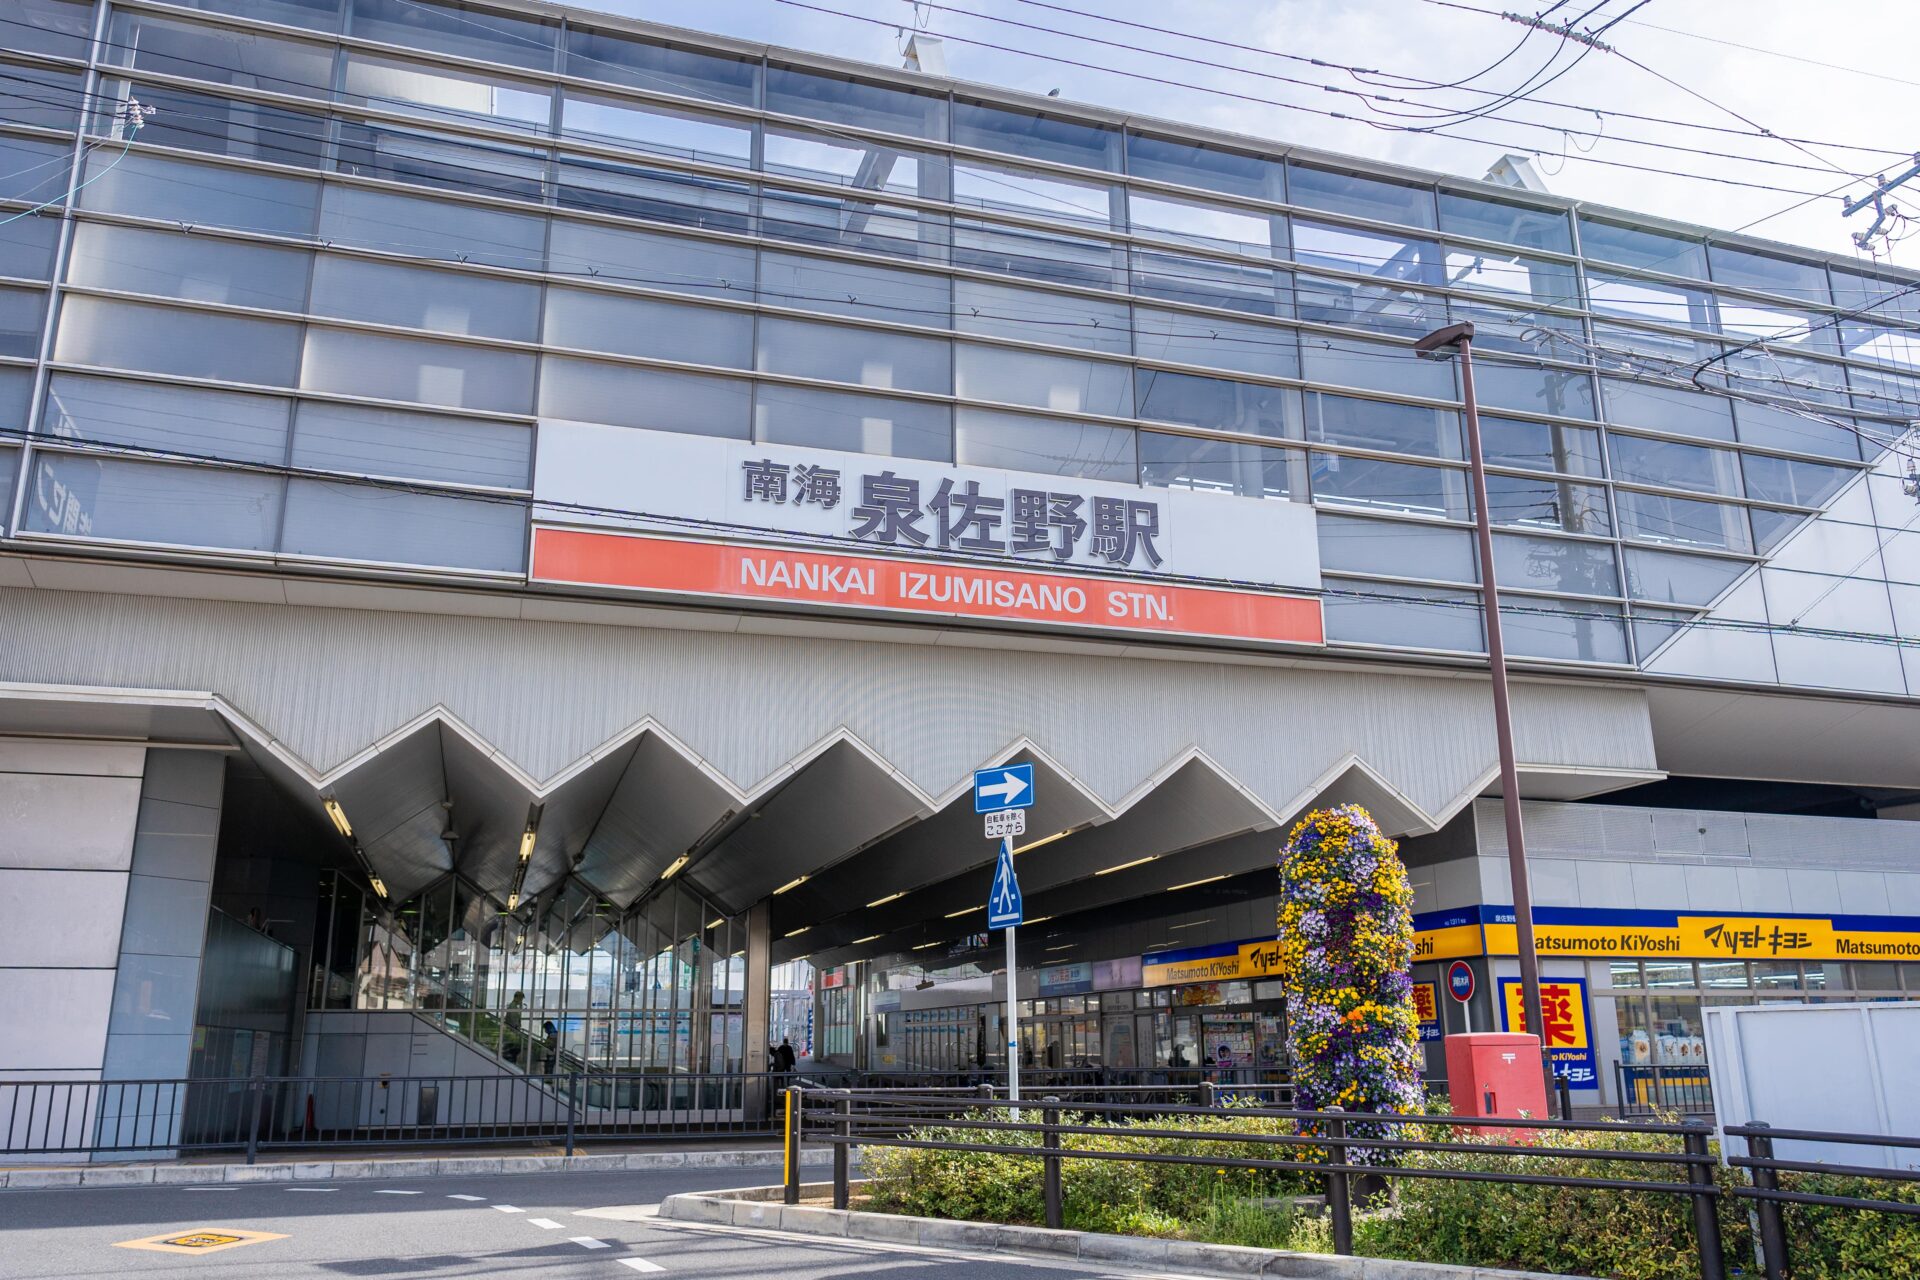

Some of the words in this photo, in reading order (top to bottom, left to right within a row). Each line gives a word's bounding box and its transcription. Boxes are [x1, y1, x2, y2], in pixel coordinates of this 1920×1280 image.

[742, 459, 841, 508] 南海
[848, 470, 1164, 568] 泉佐野駅
[741, 558, 875, 595] NANKAI
[900, 571, 1086, 614] IZUMISANO
[1108, 590, 1174, 621] STN.
[986, 821, 1023, 836] ここから
[1535, 935, 1617, 952] atsumoto
[1620, 934, 1680, 952] KiYoshi
[1704, 923, 1813, 955] マツモトキヨシ
[1836, 938, 1920, 955] Matsumoto
[1166, 963, 1209, 983] Matsumoto
[1209, 960, 1240, 978] KiYoshi
[1516, 984, 1577, 1047] 薬
